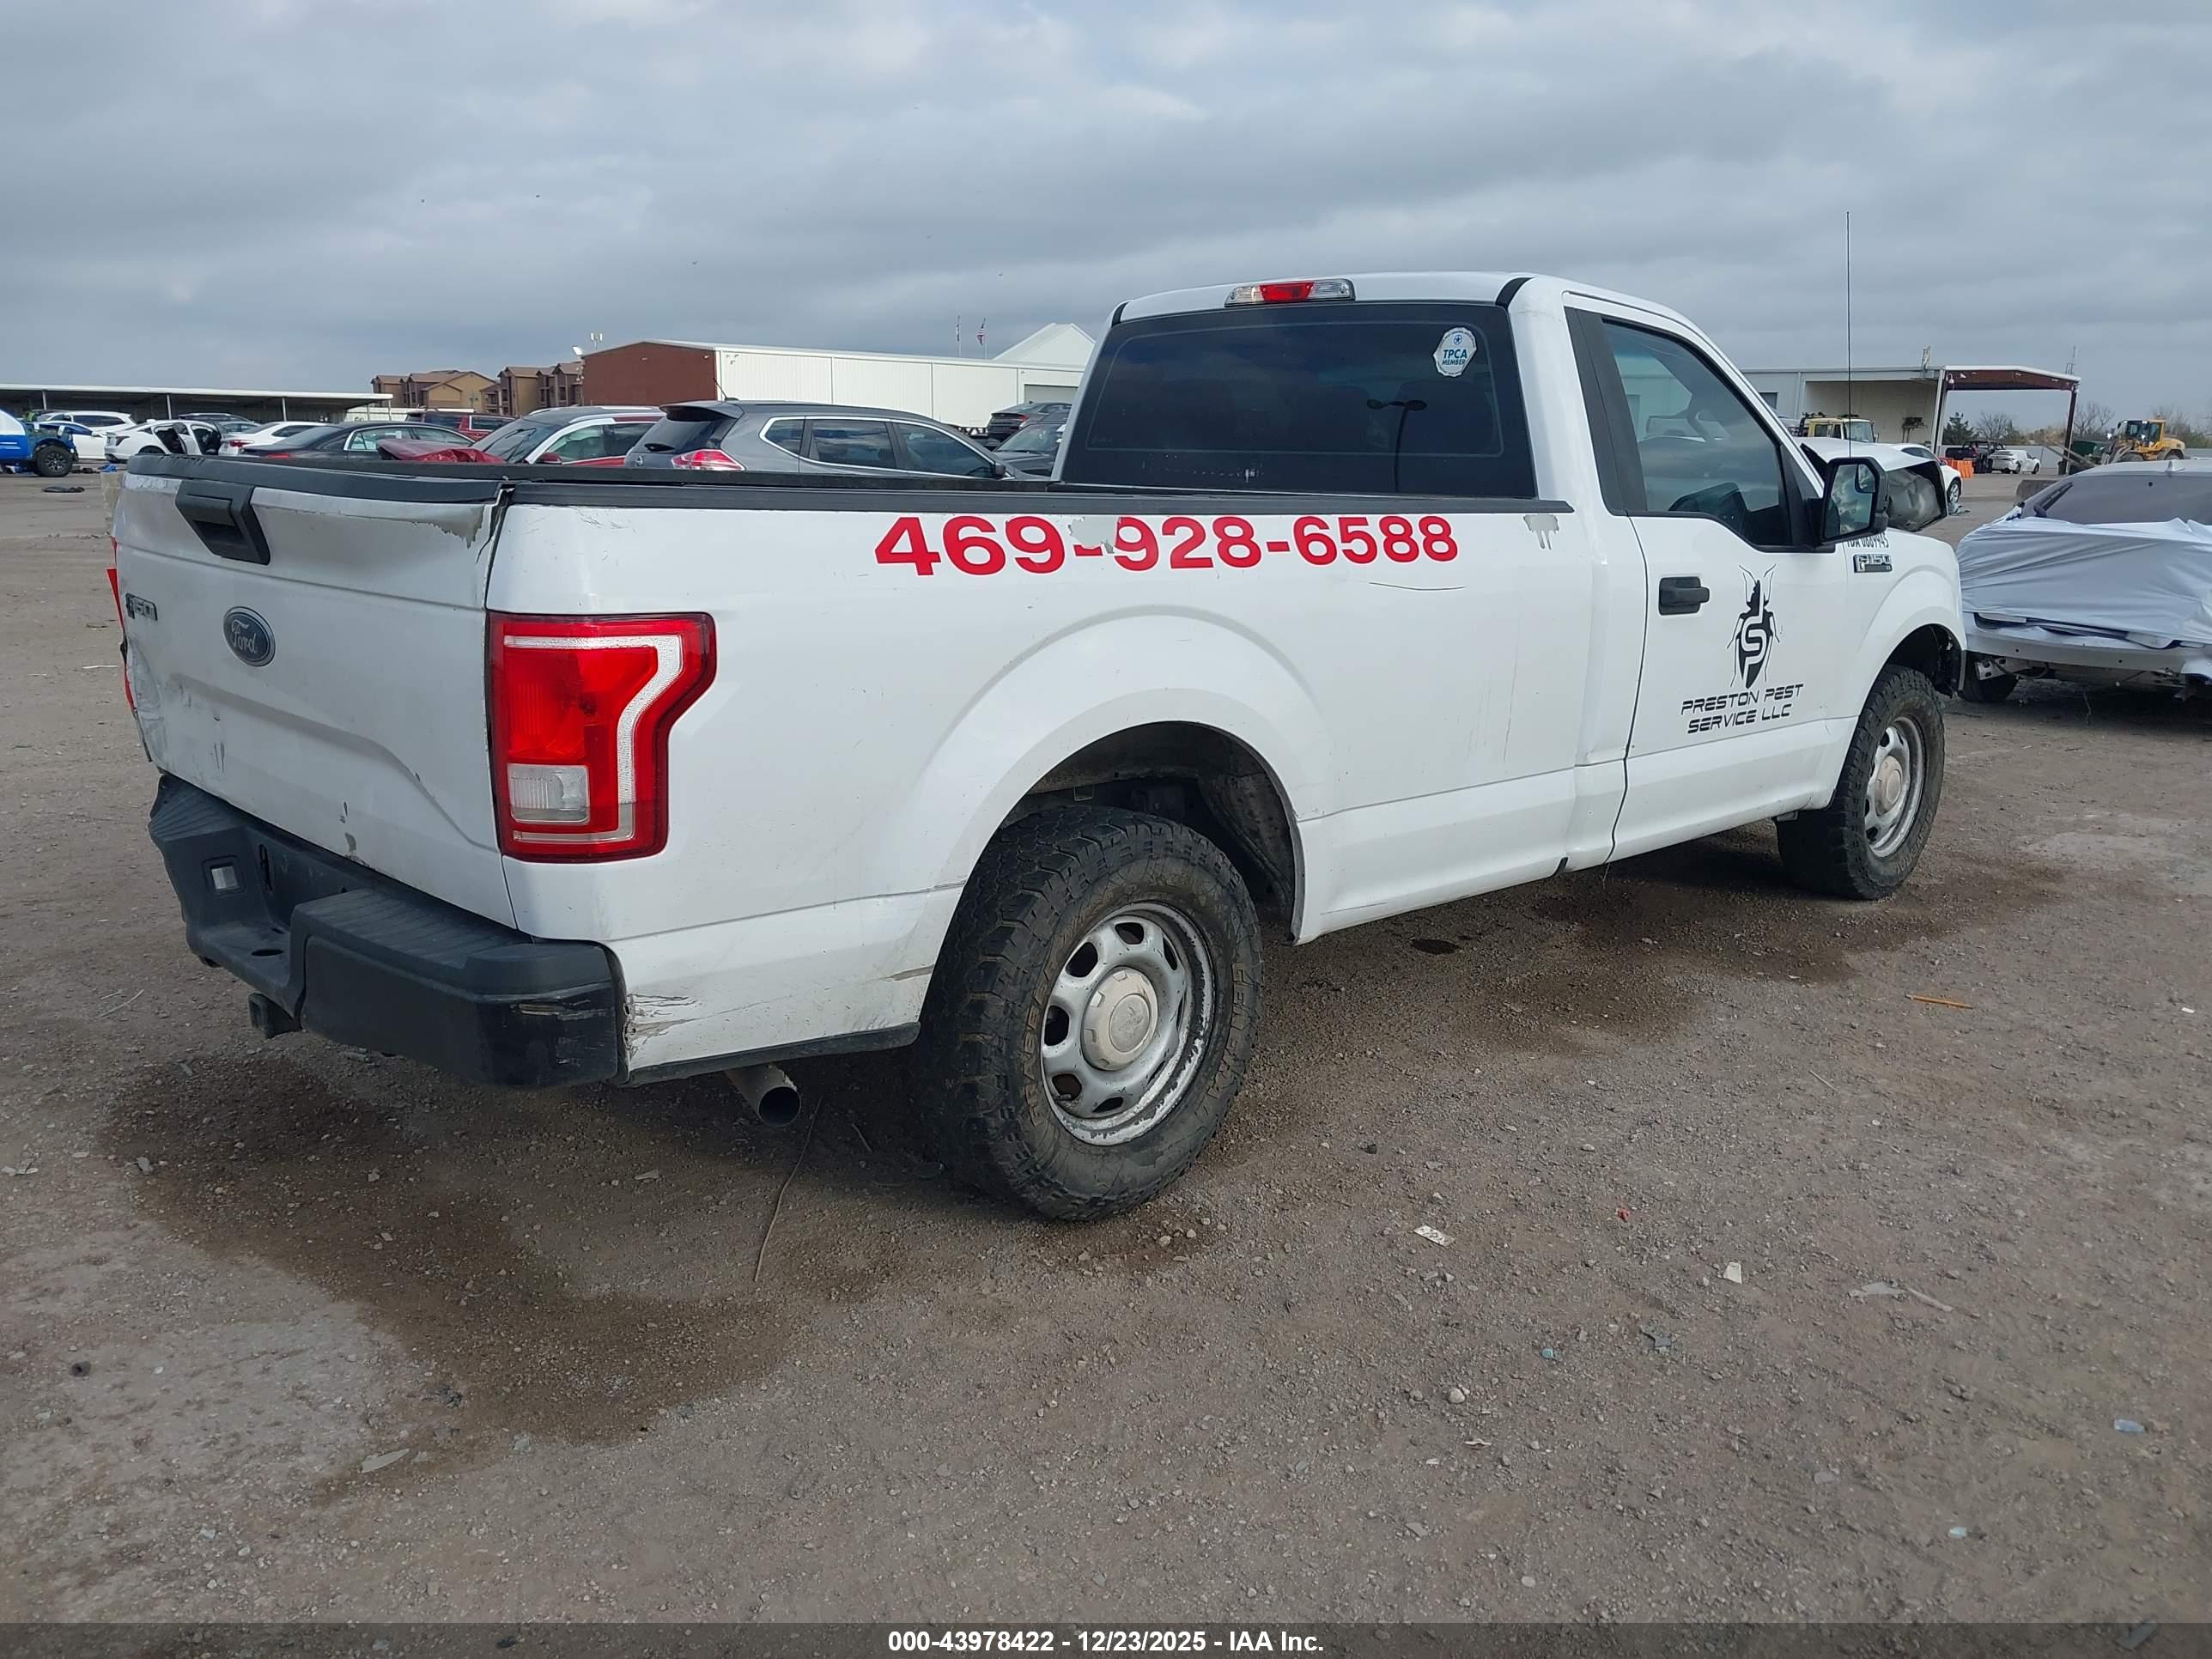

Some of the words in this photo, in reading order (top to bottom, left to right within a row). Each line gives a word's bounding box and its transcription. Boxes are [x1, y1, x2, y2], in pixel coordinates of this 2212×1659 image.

[1443, 349, 1468, 359] TPCA
[874, 515, 1459, 576] 469-928-6588
[230, 619, 258, 654] Ford
[1681, 690, 1760, 715] PRESTON
[1764, 684, 1804, 702] PEST
[1687, 709, 1758, 734] SERVICE
[1761, 703, 1792, 721] LLC
